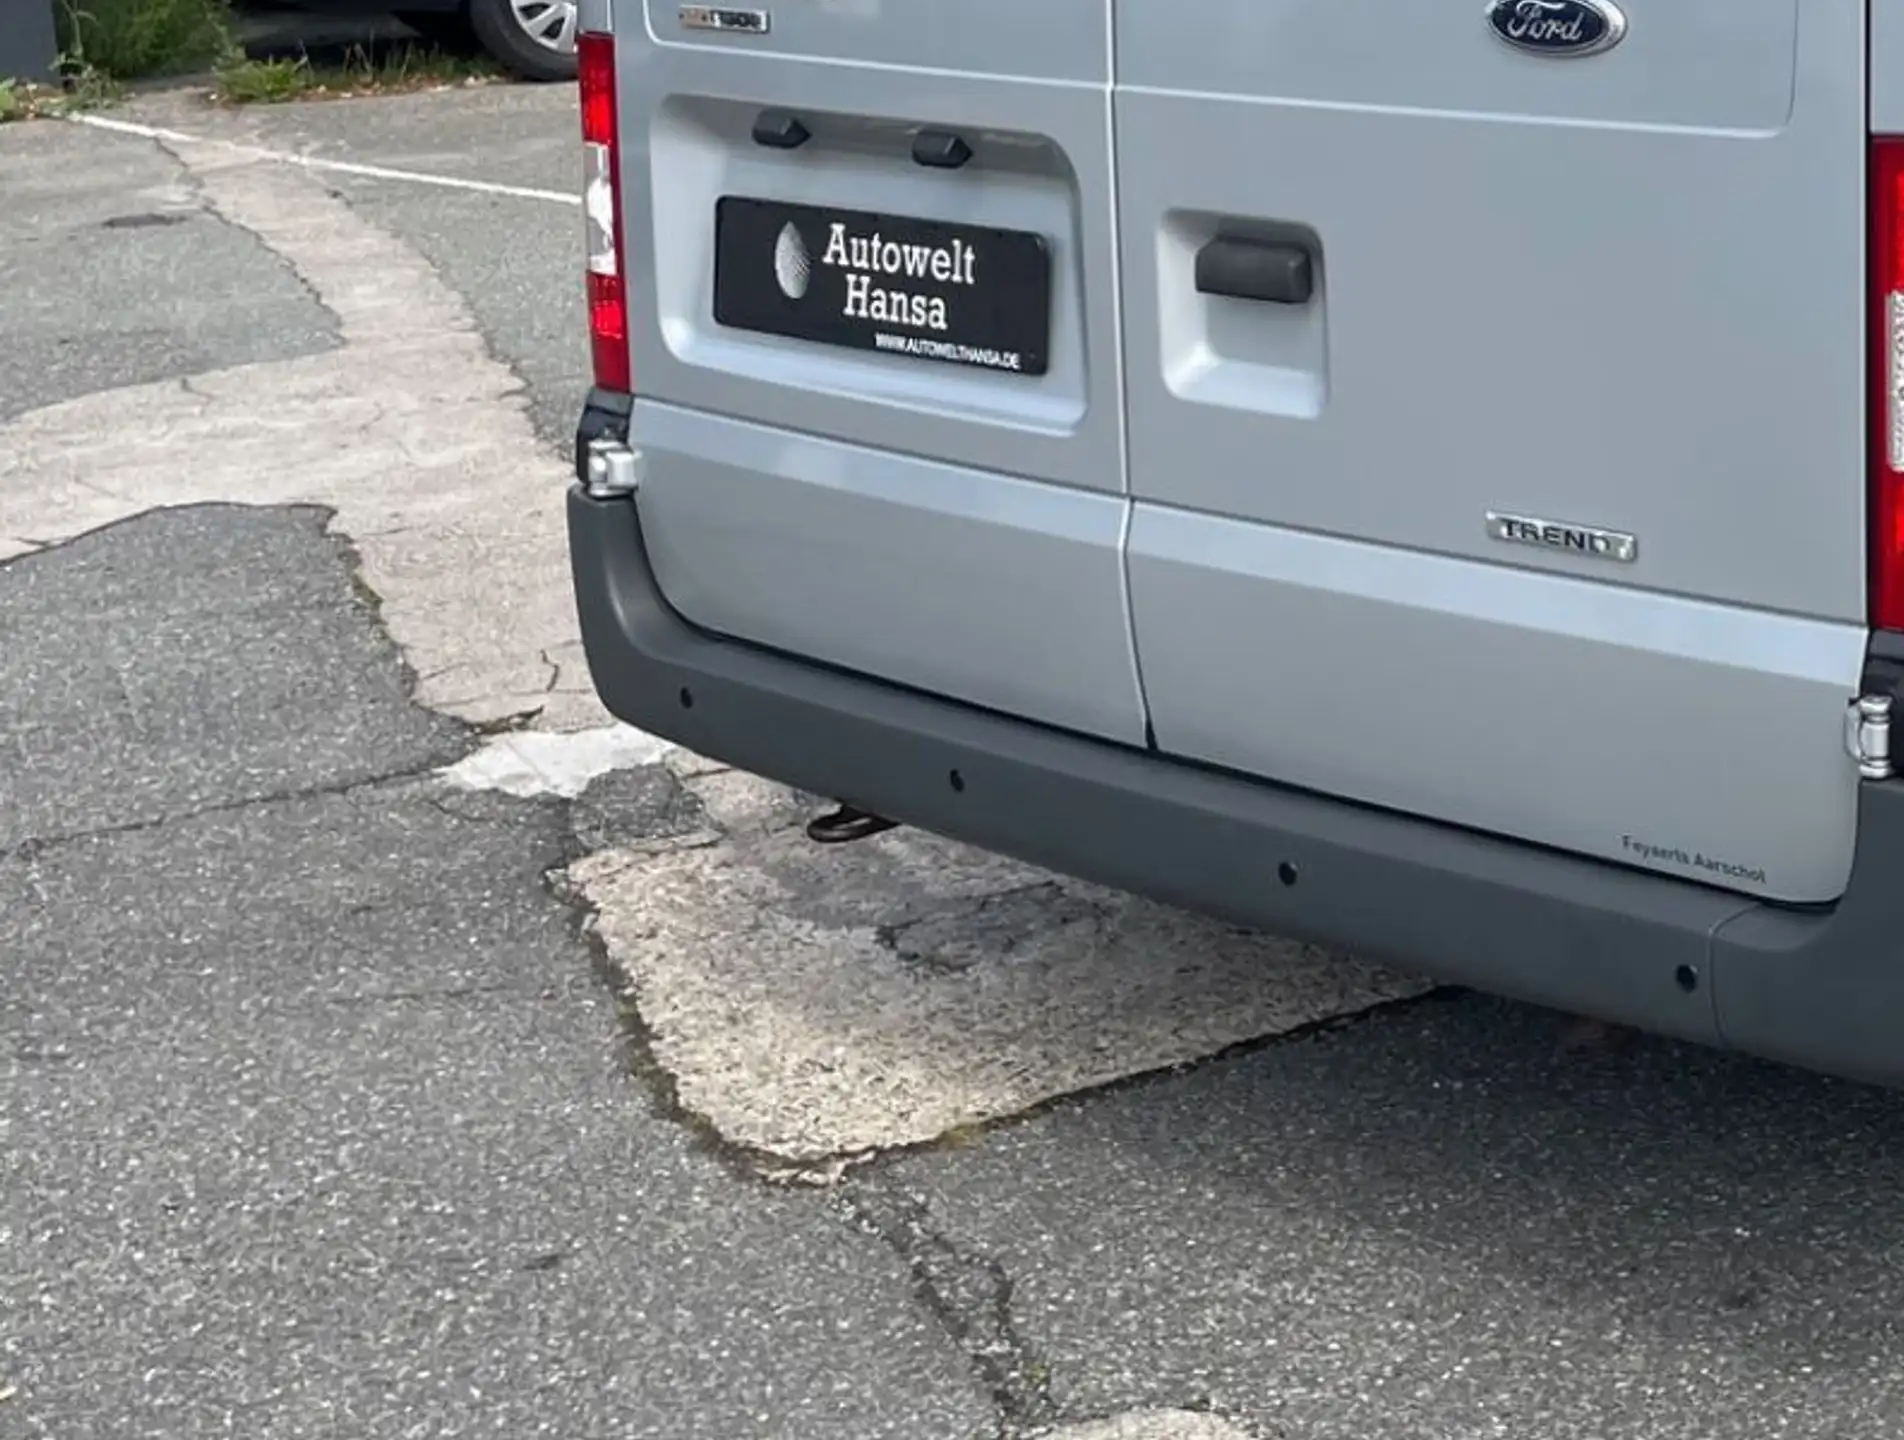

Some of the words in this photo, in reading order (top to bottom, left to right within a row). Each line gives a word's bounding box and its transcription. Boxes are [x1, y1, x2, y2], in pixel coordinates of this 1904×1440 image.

[823, 222, 977, 284] Autowelt
[843, 274, 949, 331] Hansa
[1499, 518, 1612, 553] TREND
